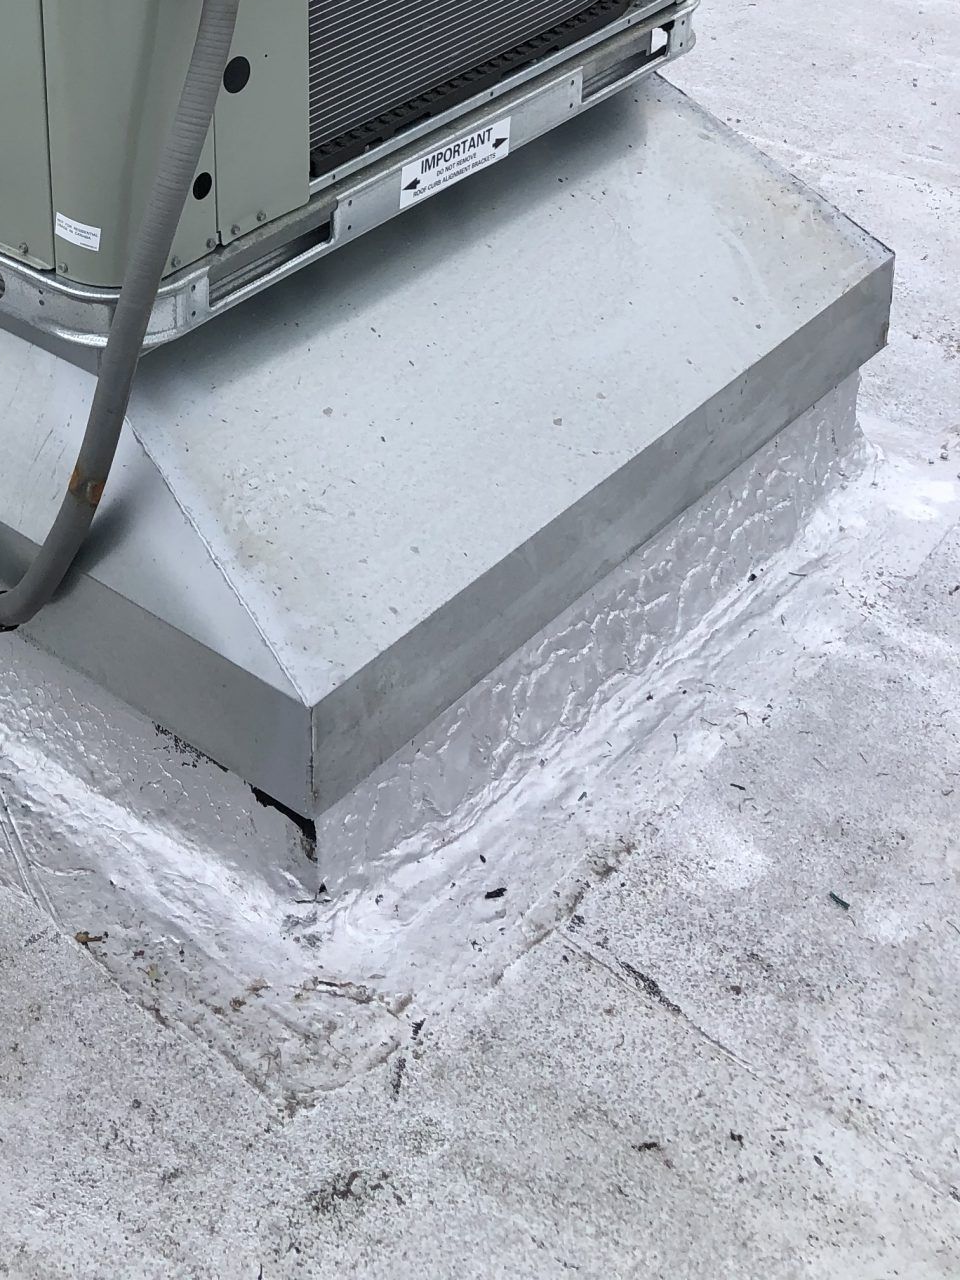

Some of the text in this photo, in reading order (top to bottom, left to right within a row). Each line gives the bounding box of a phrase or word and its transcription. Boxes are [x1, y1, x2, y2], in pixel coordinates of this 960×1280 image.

[421, 127, 493, 174] IMPORTANT
[436, 152, 477, 177] DO NOT REMOVE
[442, 164, 471, 183] ALIGNMENT
[471, 152, 496, 169] BRACKETS
